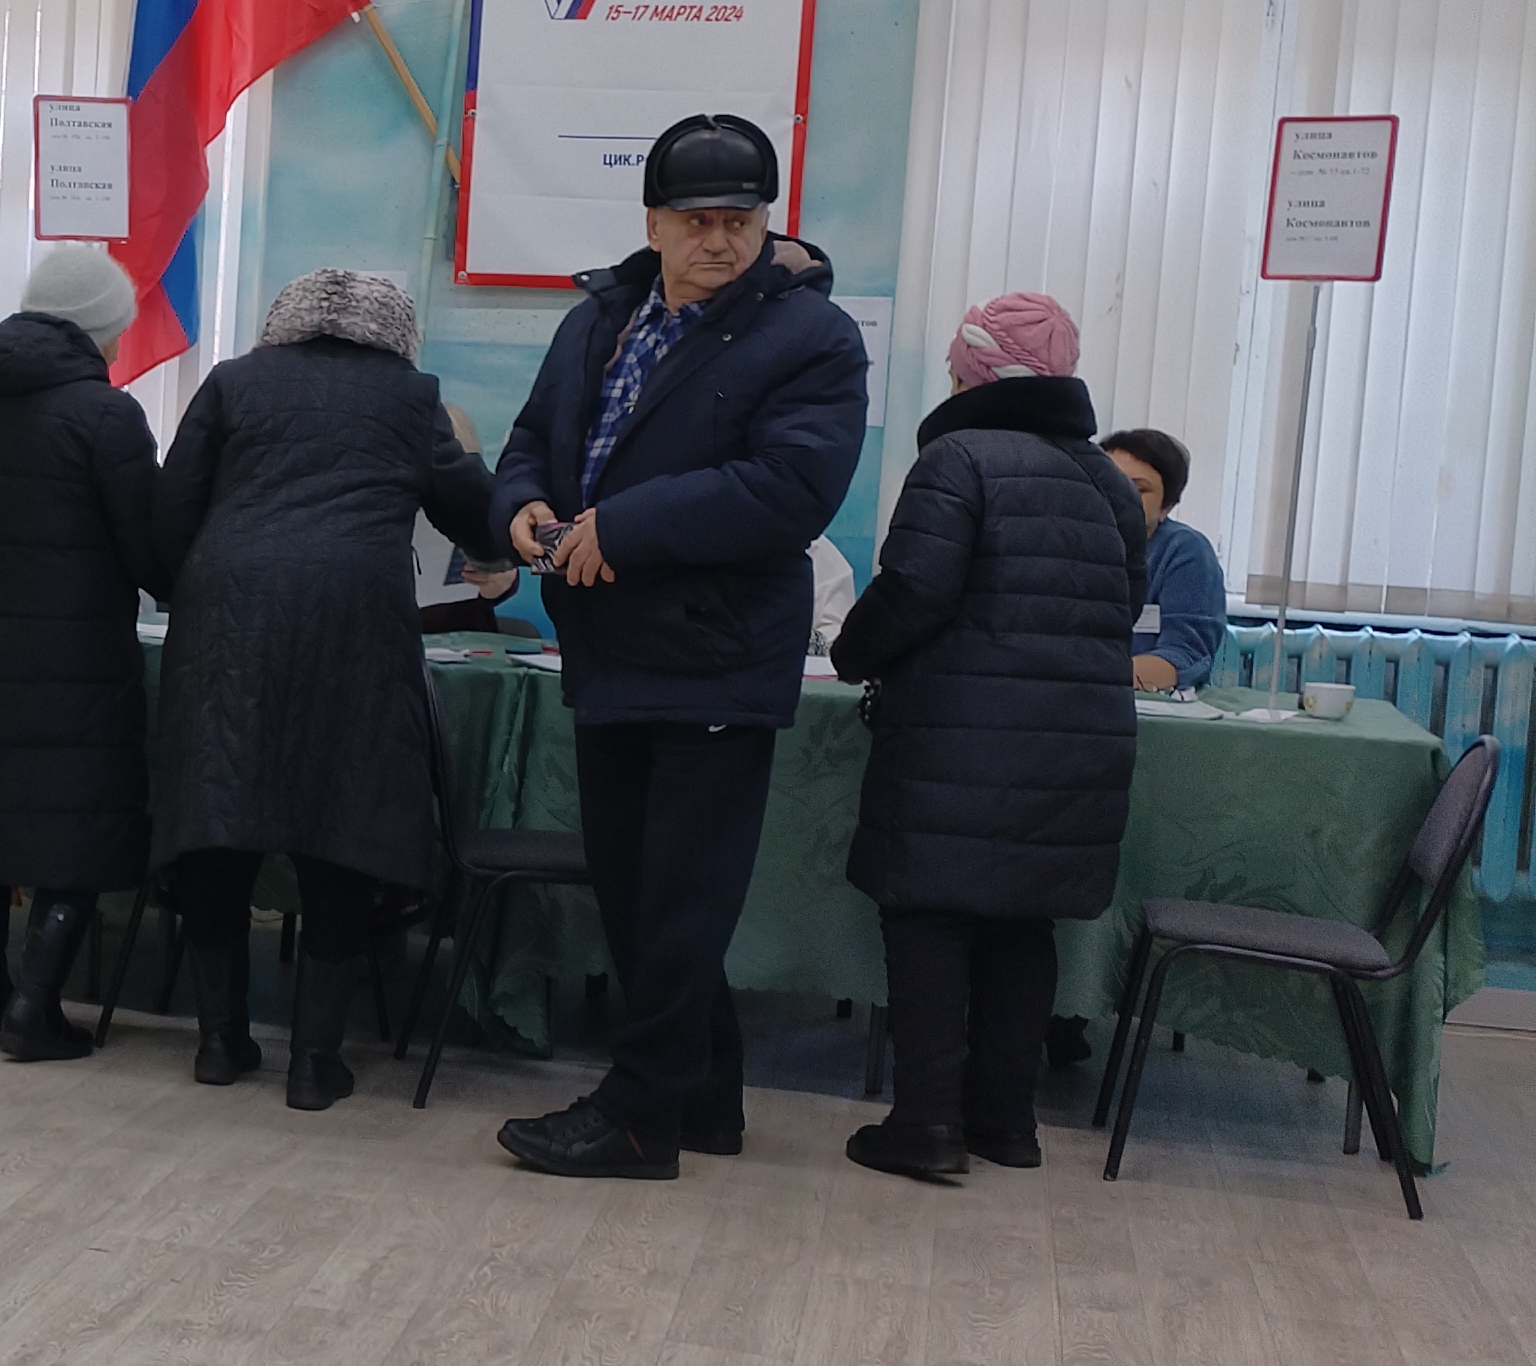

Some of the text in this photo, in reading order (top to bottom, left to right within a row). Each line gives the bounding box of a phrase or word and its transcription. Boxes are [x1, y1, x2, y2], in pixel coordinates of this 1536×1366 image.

[649, 5, 702, 21] МАРТА
[705, 6, 745, 21] 2024
[50, 117, 113, 128] Полтавская
[1293, 149, 1378, 160] Космонавтов
[602, 153, 645, 168] ЦИК.Р
[50, 178, 114, 189] Полтавская
[1286, 217, 1371, 229] Космонавтов
